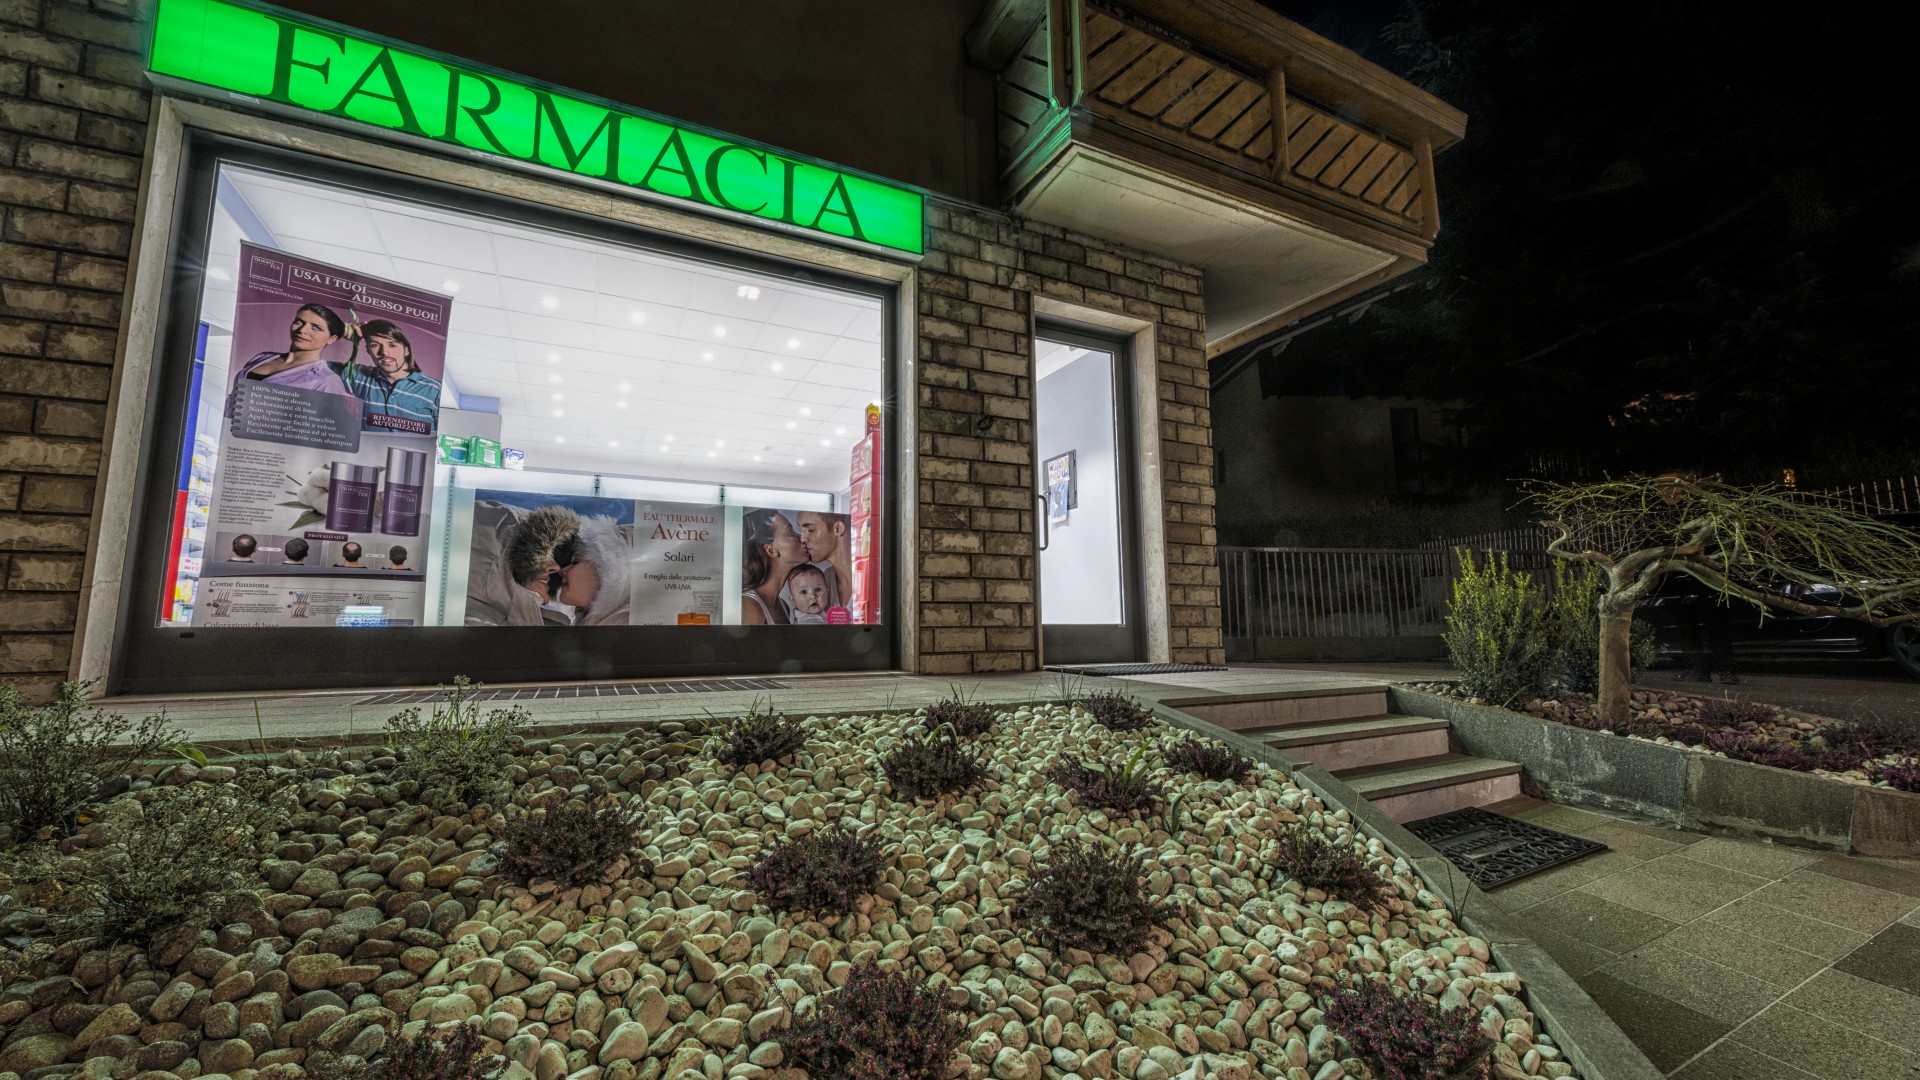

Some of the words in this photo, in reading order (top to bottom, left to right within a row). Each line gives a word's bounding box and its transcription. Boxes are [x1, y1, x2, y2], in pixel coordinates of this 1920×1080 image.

[257, 14, 871, 242] FARMACIA
[294, 269, 321, 283] USA
[325, 277, 331, 285] I
[333, 279, 367, 294] TUOI
[352, 294, 403, 312] ADESSO
[405, 306, 438, 321] PUOI!
[272, 388, 300, 397] Naturale
[256, 400, 293, 411] colorazioni
[248, 413, 292, 424] Applicazione
[309, 416, 335, 424] macchia
[373, 415, 426, 428] RIVENDITORE
[247, 420, 281, 430] Resistente
[283, 426, 310, 434] all'acqua
[373, 420, 425, 433] AUTORIZZATO
[246, 427, 283, 437] Facilmente
[324, 439, 352, 447] shampoo
[643, 512, 663, 520] EAU
[665, 514, 717, 524] THERMALE
[650, 522, 710, 541] Avène
[664, 552, 694, 562] Solari
[649, 573, 667, 581] meglio
[235, 580, 269, 588] funziona
